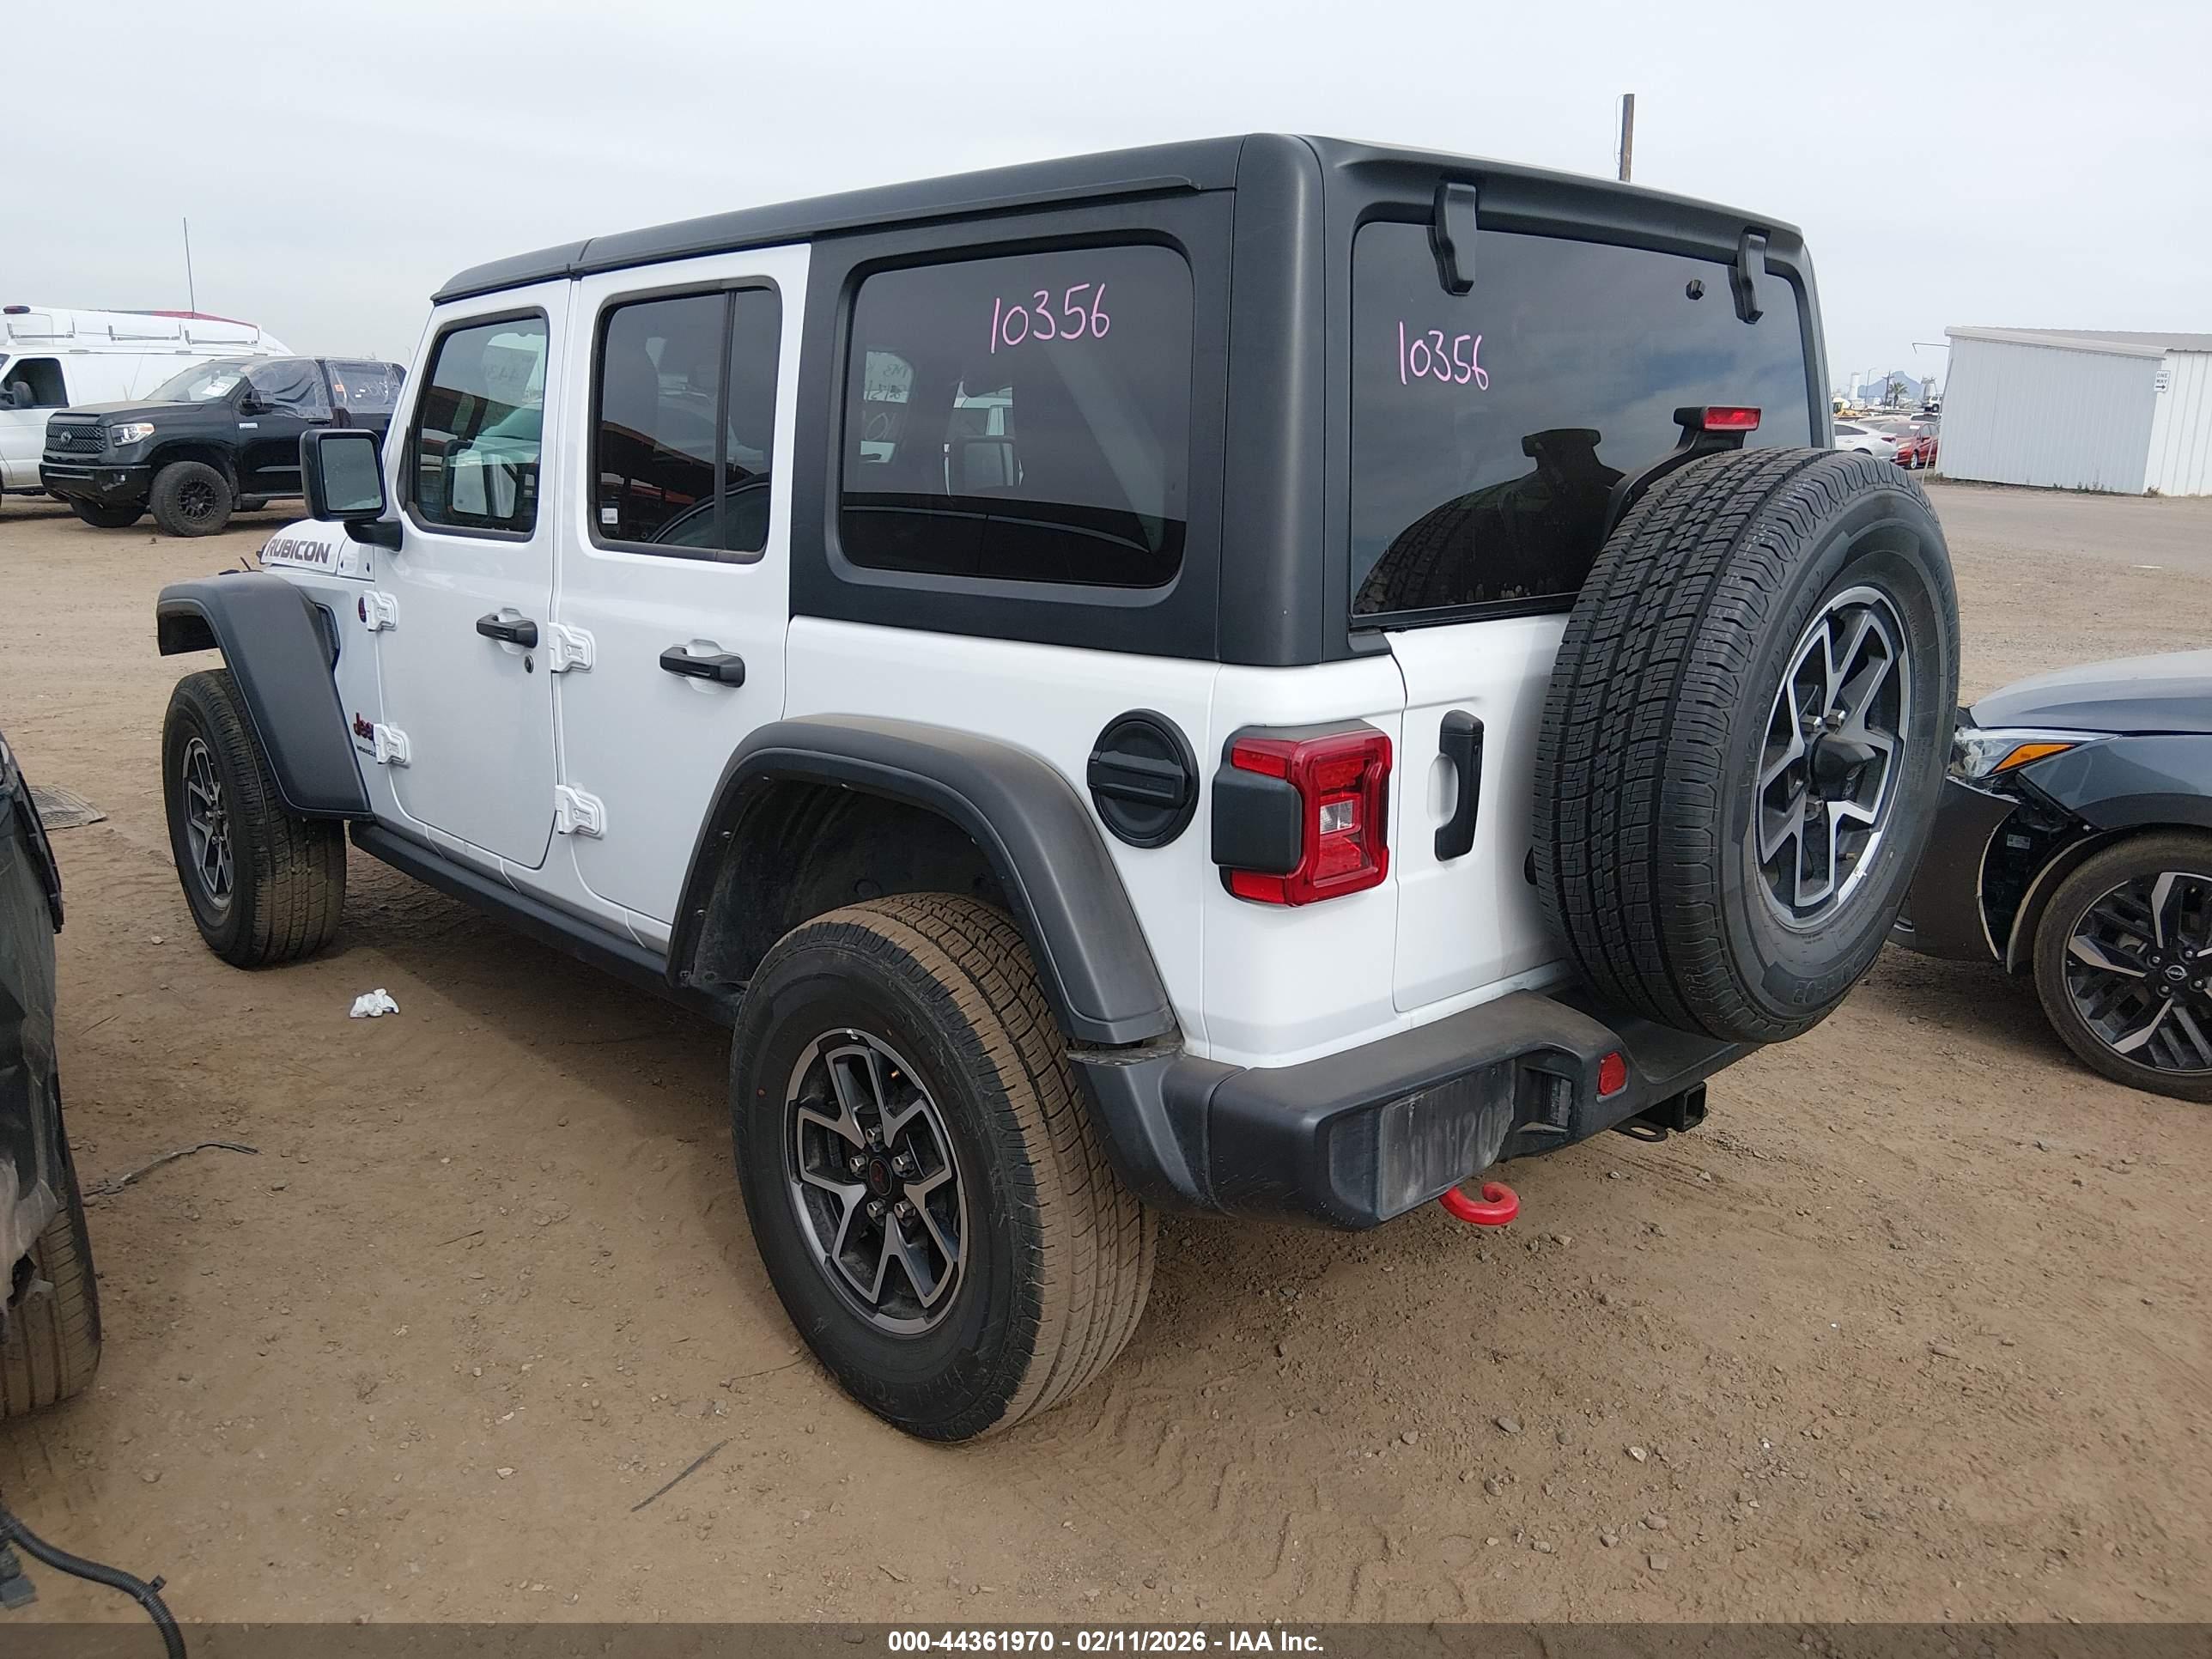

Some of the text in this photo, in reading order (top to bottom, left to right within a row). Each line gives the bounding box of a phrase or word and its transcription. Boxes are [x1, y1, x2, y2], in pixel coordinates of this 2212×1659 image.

[990, 282, 1110, 355] 10356
[1399, 320, 1489, 391] 10356
[265, 538, 331, 564] RUBICON
